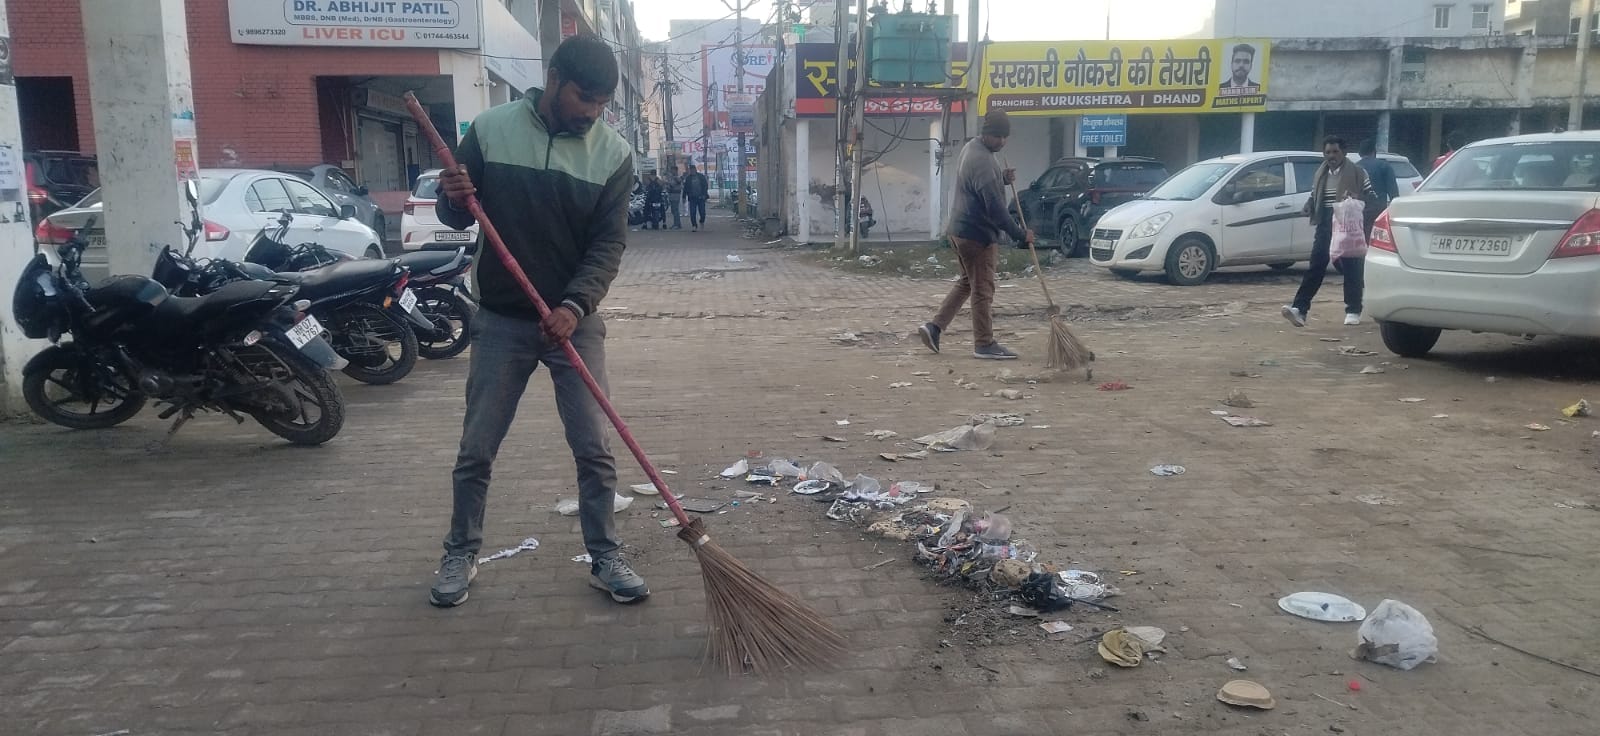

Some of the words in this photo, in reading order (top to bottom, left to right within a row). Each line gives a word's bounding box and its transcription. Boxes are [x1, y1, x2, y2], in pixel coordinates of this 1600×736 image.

[294, 0, 322, 12] DR.
[328, 1, 396, 13] ABHIJIT
[402, 2, 449, 14] PATIL
[303, 27, 362, 40] LIVER
[370, 28, 405, 41] ICU
[989, 47, 1060, 89] सरकारी
[1064, 47, 1123, 87] नौकरी
[1127, 45, 1155, 86] की
[1159, 45, 1212, 86] तैयारी
[1041, 94, 1132, 106] KURUKSHETRA
[1153, 94, 1201, 105] DHAND
[1081, 134, 1099, 144] FREE
[1099, 134, 1124, 144] TOILET
[1438, 238, 1453, 249] HR
[1479, 239, 1509, 252] 2360
[293, 324, 304, 336] HR
[301, 318, 312, 330] 07
[302, 323, 320, 341] 1767
